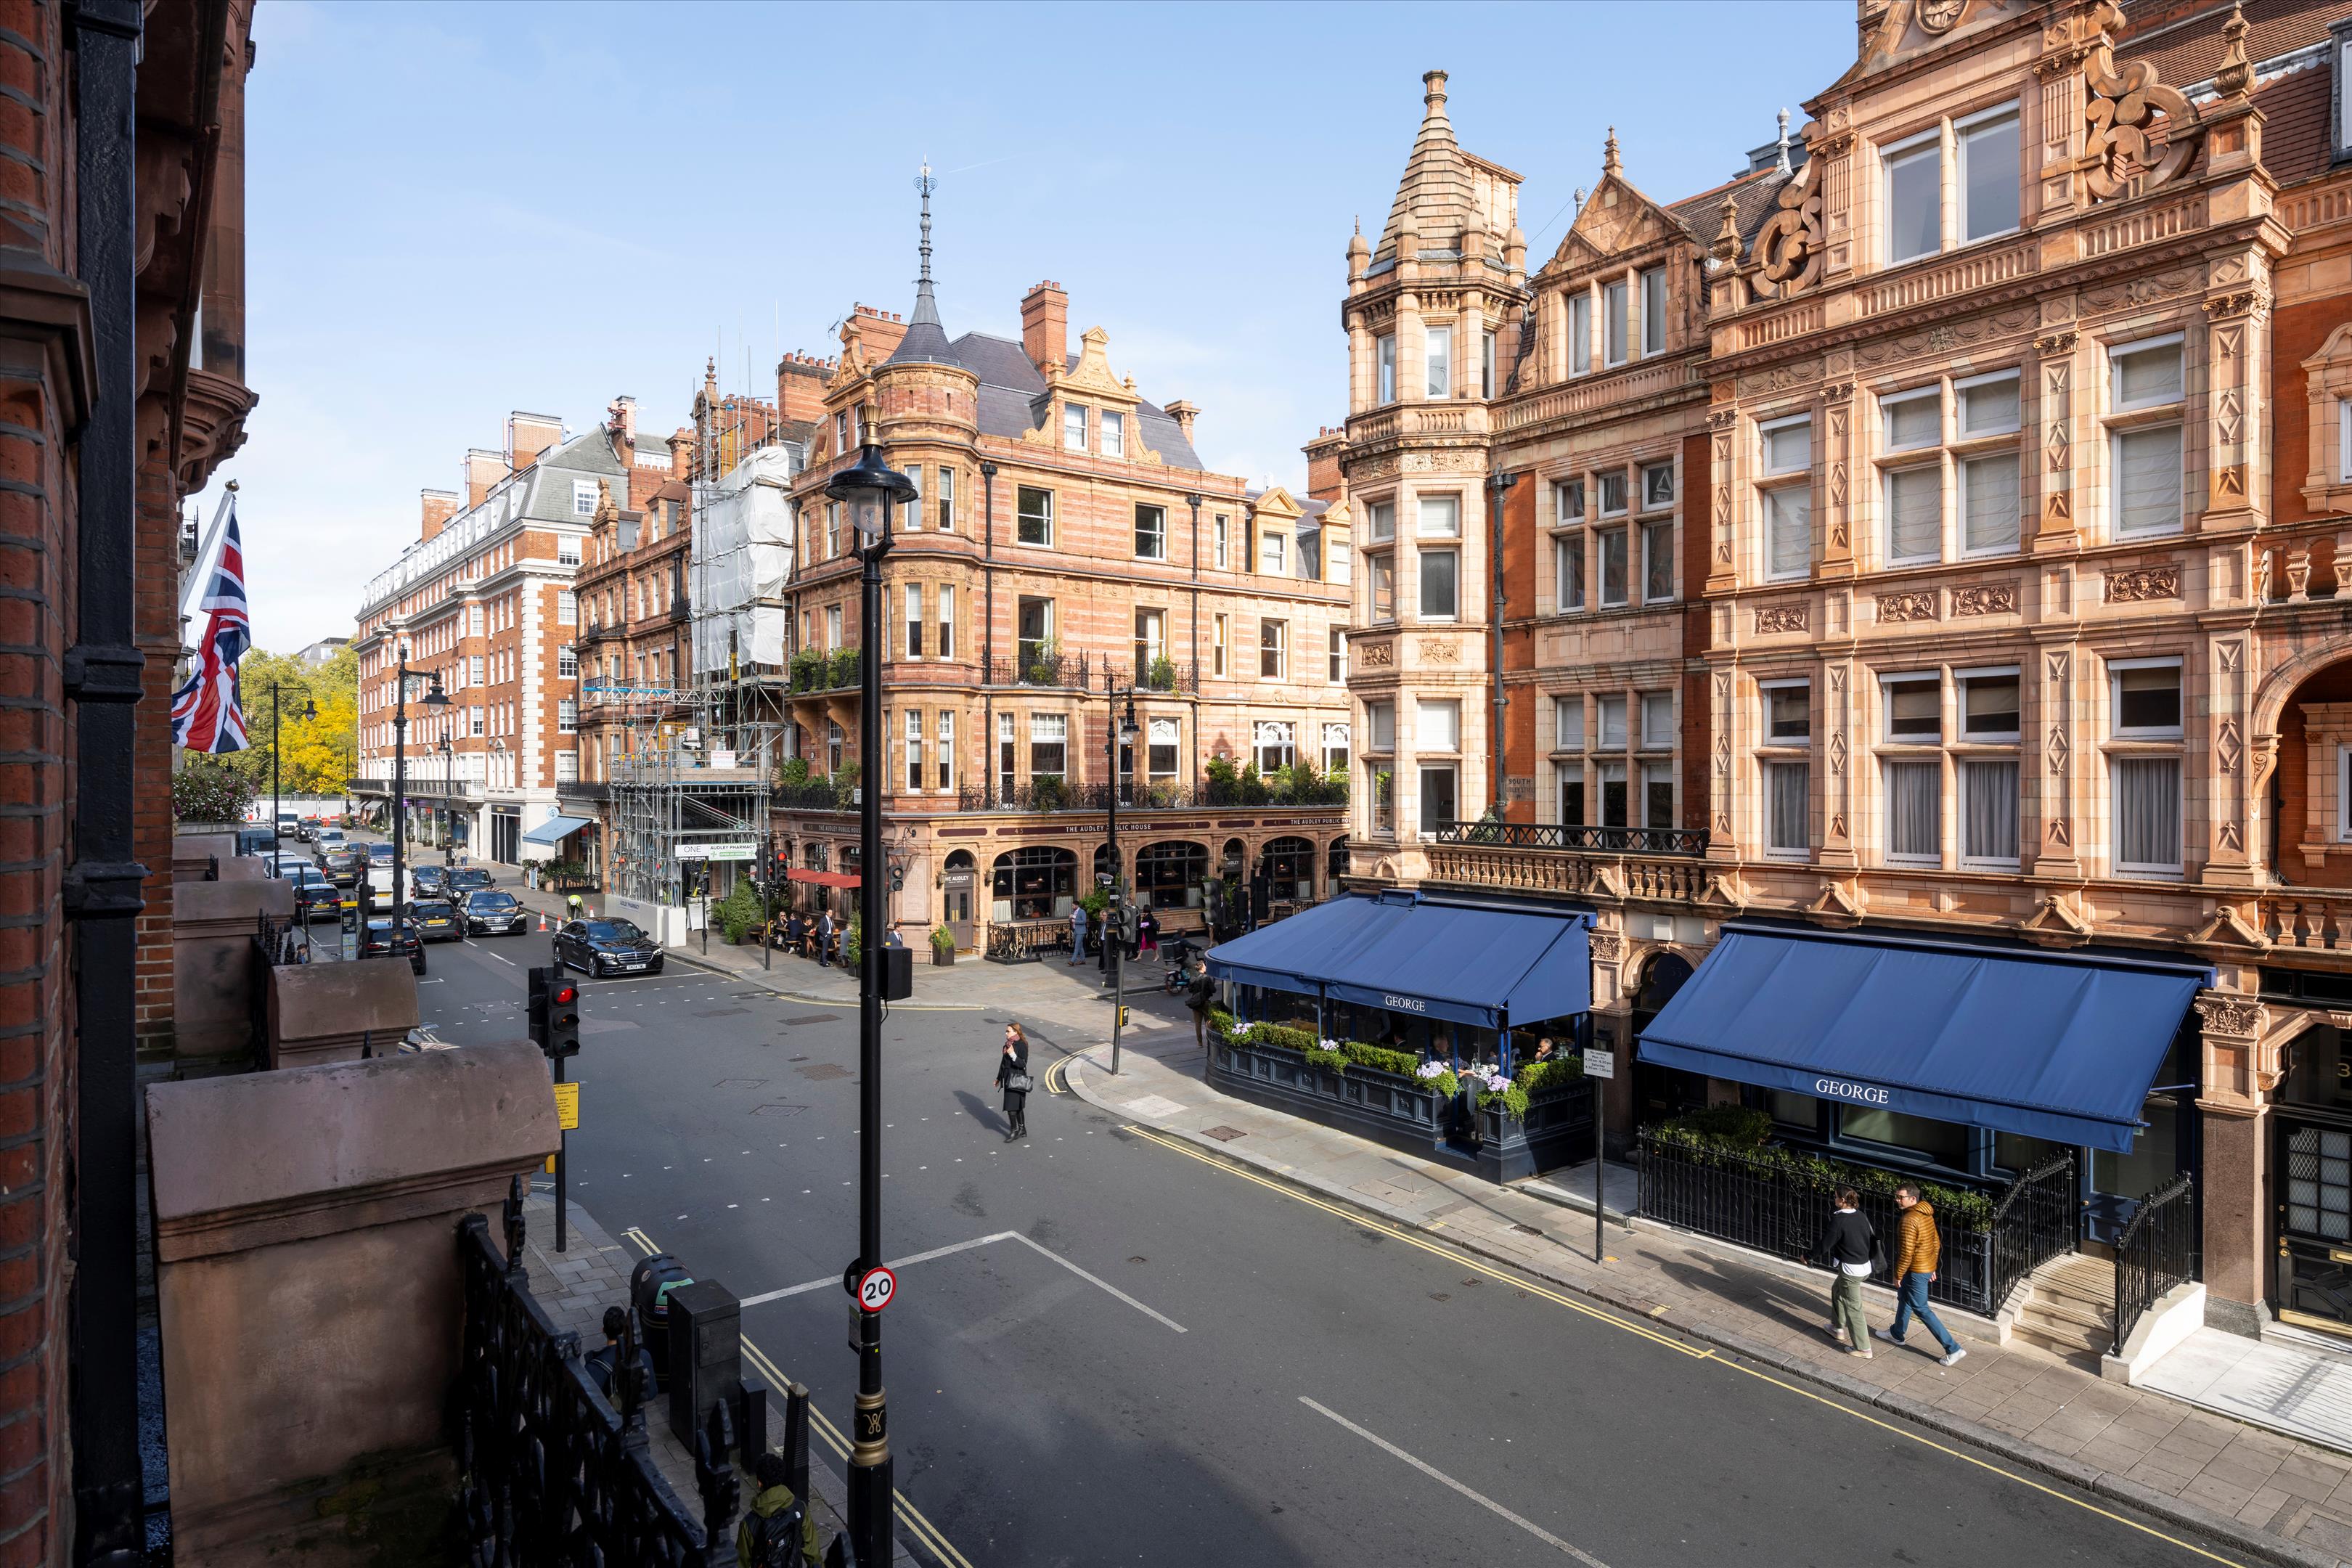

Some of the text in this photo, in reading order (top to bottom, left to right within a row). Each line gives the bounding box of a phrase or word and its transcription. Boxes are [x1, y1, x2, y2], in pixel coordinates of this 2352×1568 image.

[1385, 995, 1426, 1012] GEORGE
[1816, 1079, 1889, 1104] GEORGE
[865, 1278, 891, 1302] 20
